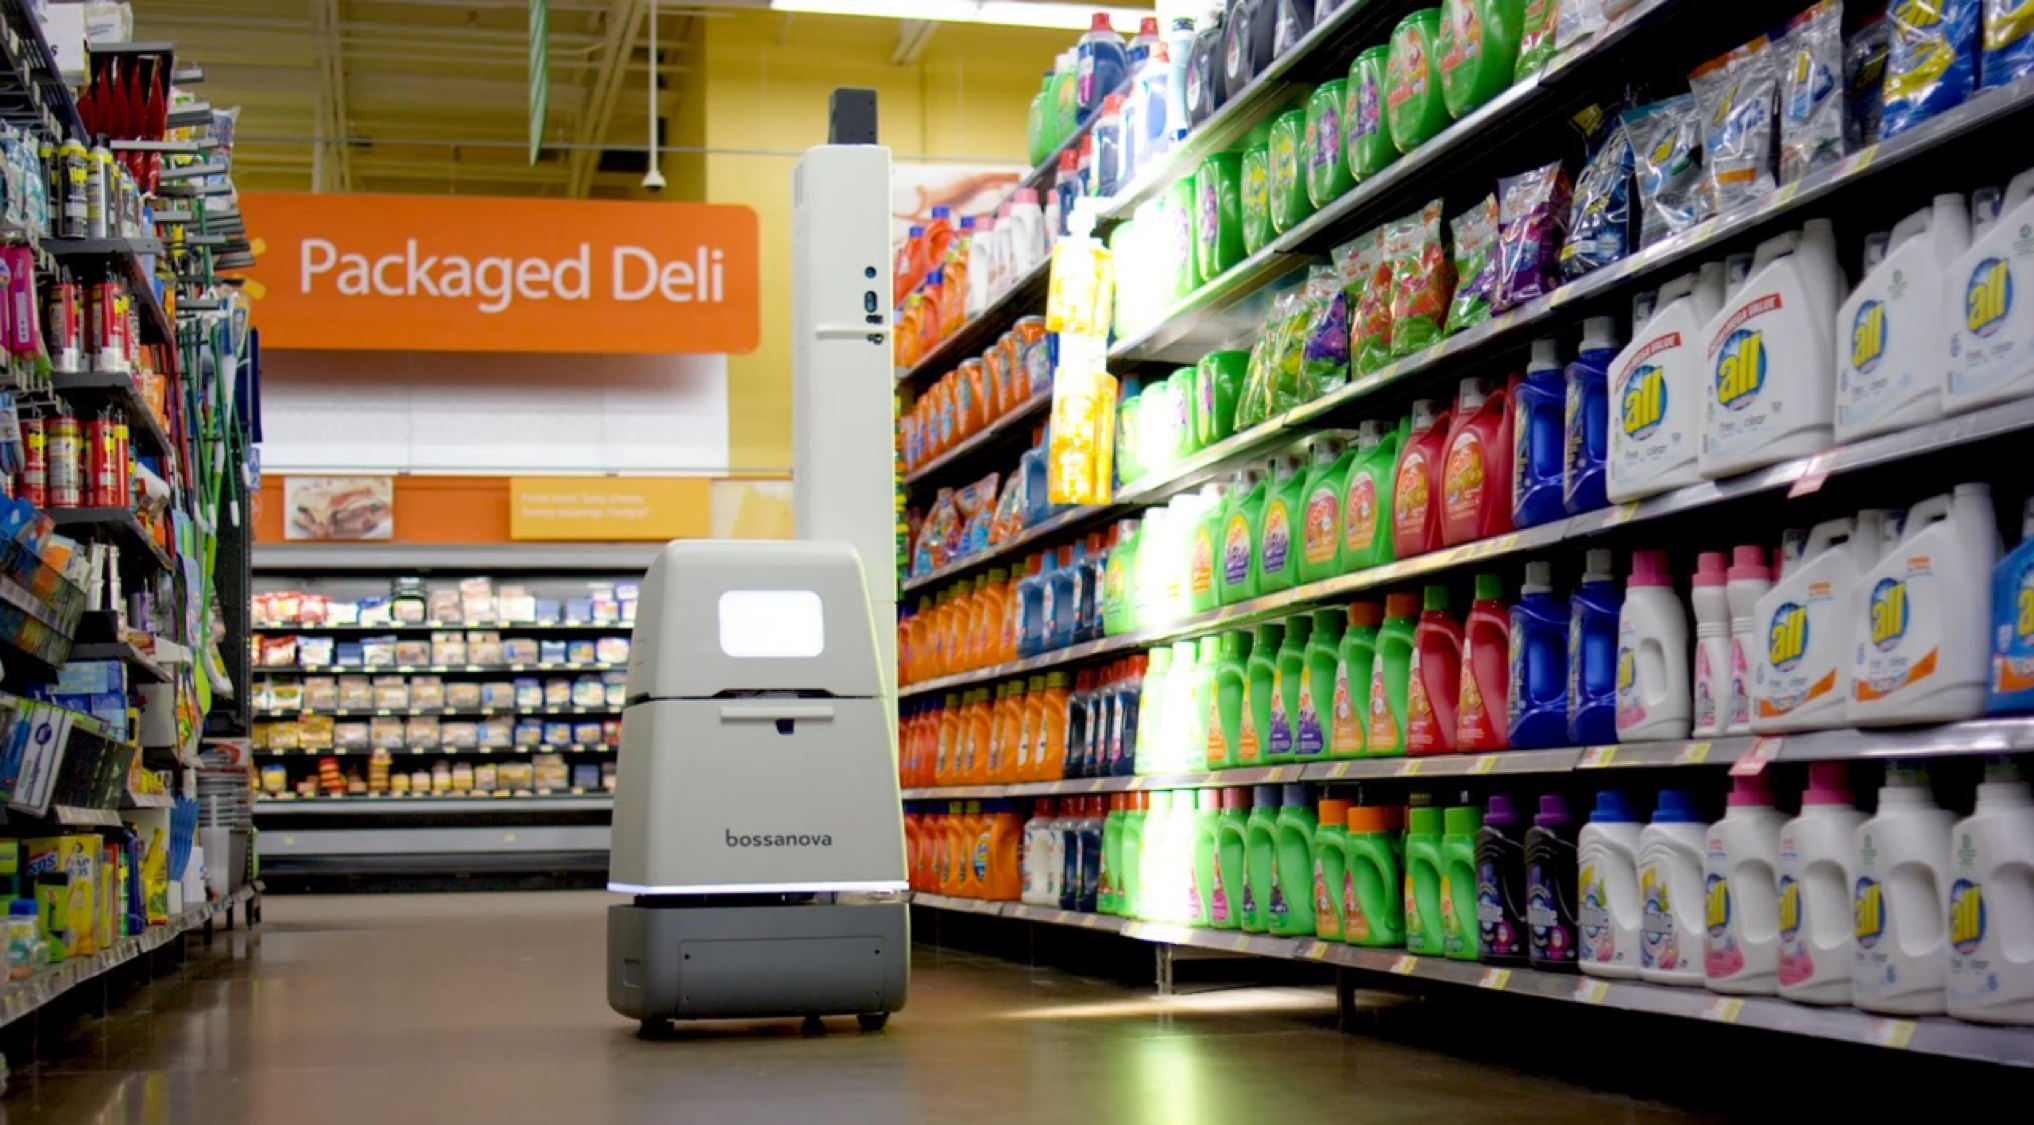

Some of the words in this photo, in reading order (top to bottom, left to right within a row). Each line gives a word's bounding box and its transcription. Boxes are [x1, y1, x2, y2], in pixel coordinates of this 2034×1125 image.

[300, 238, 591, 314] Packaged
[612, 244, 724, 304] Deli
[1967, 257, 2010, 332] all
[1717, 330, 1762, 402] all
[1853, 301, 1884, 370] all
[1622, 366, 1663, 435] all
[1769, 605, 1806, 665] all
[1870, 581, 1905, 645] all
[725, 828, 833, 848] bossanova
[1948, 885, 1983, 945] all
